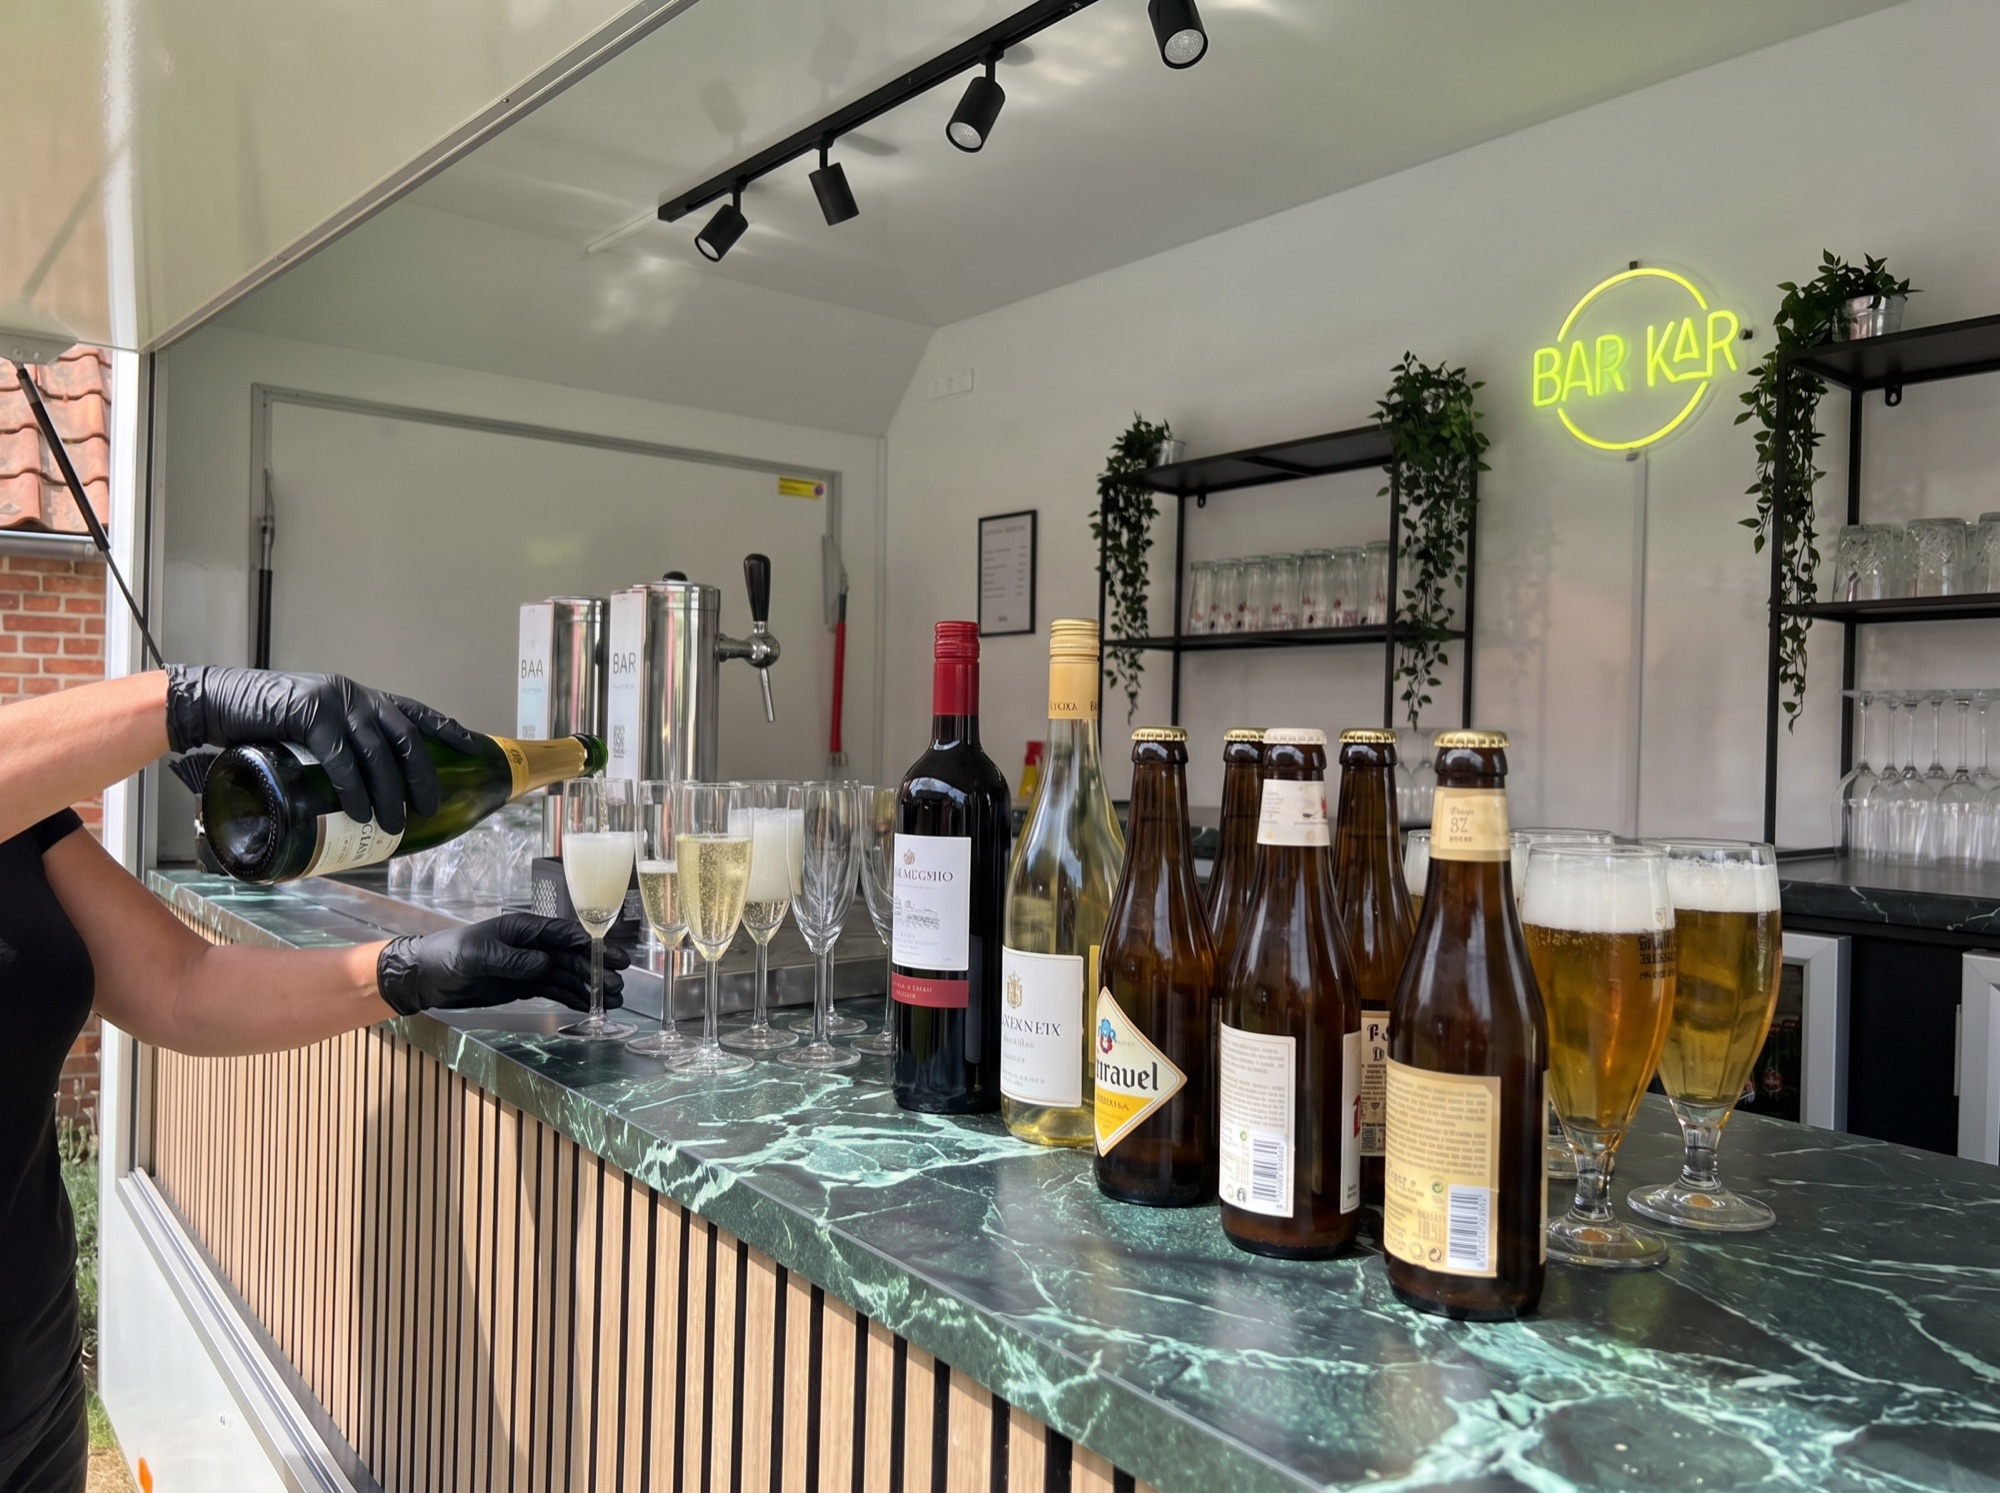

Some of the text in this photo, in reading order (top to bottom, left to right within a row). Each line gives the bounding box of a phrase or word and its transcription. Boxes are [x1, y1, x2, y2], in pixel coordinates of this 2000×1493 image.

[1533, 310, 1739, 407] BAR KAR
[612, 652, 637, 674] BAR
